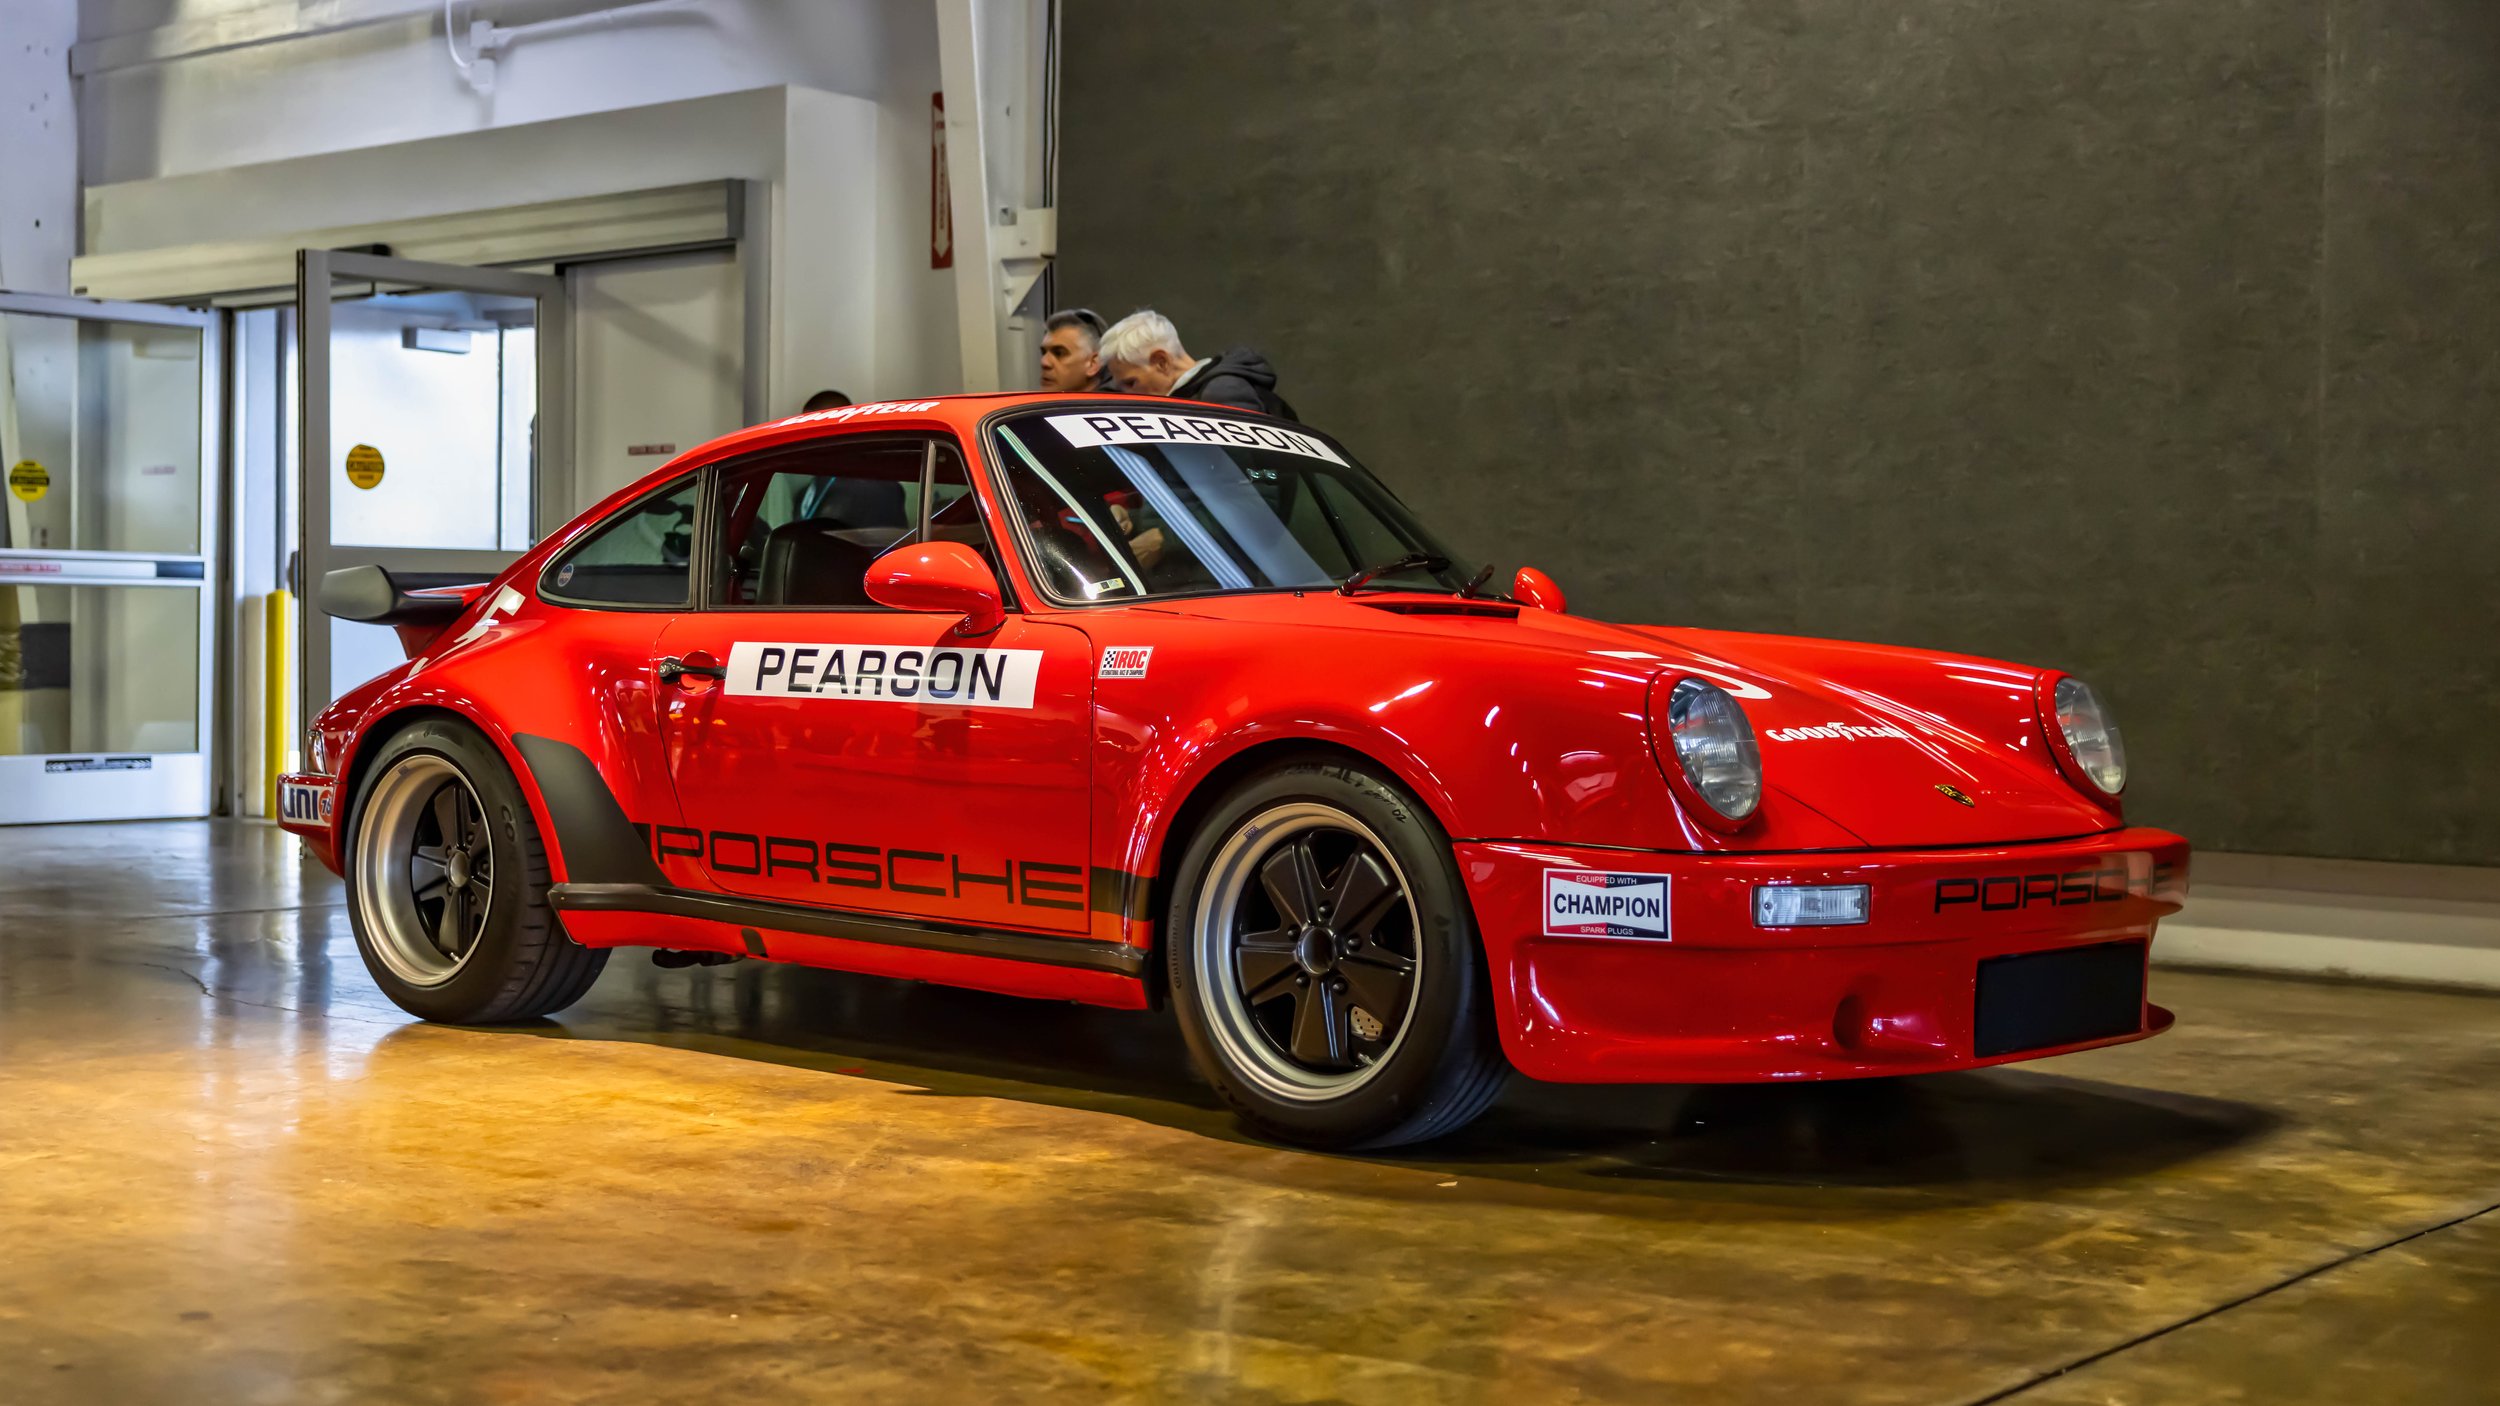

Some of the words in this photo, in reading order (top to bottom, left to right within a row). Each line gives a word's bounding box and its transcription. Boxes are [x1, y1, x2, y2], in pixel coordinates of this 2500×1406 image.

[1083, 416, 1322, 457] PEARSON
[755, 647, 1007, 701] PEARSON
[1112, 650, 1147, 668] IROC
[656, 824, 1085, 911] PORSCHE
[1576, 874, 1616, 884] EQUIPPED
[1616, 877, 1637, 885] WITH
[1934, 862, 2174, 913] PORSCHE
[1553, 893, 1660, 918] CHAMPION
[1580, 925, 1606, 934] SPARK
[1607, 928, 1634, 936] PLUGS
